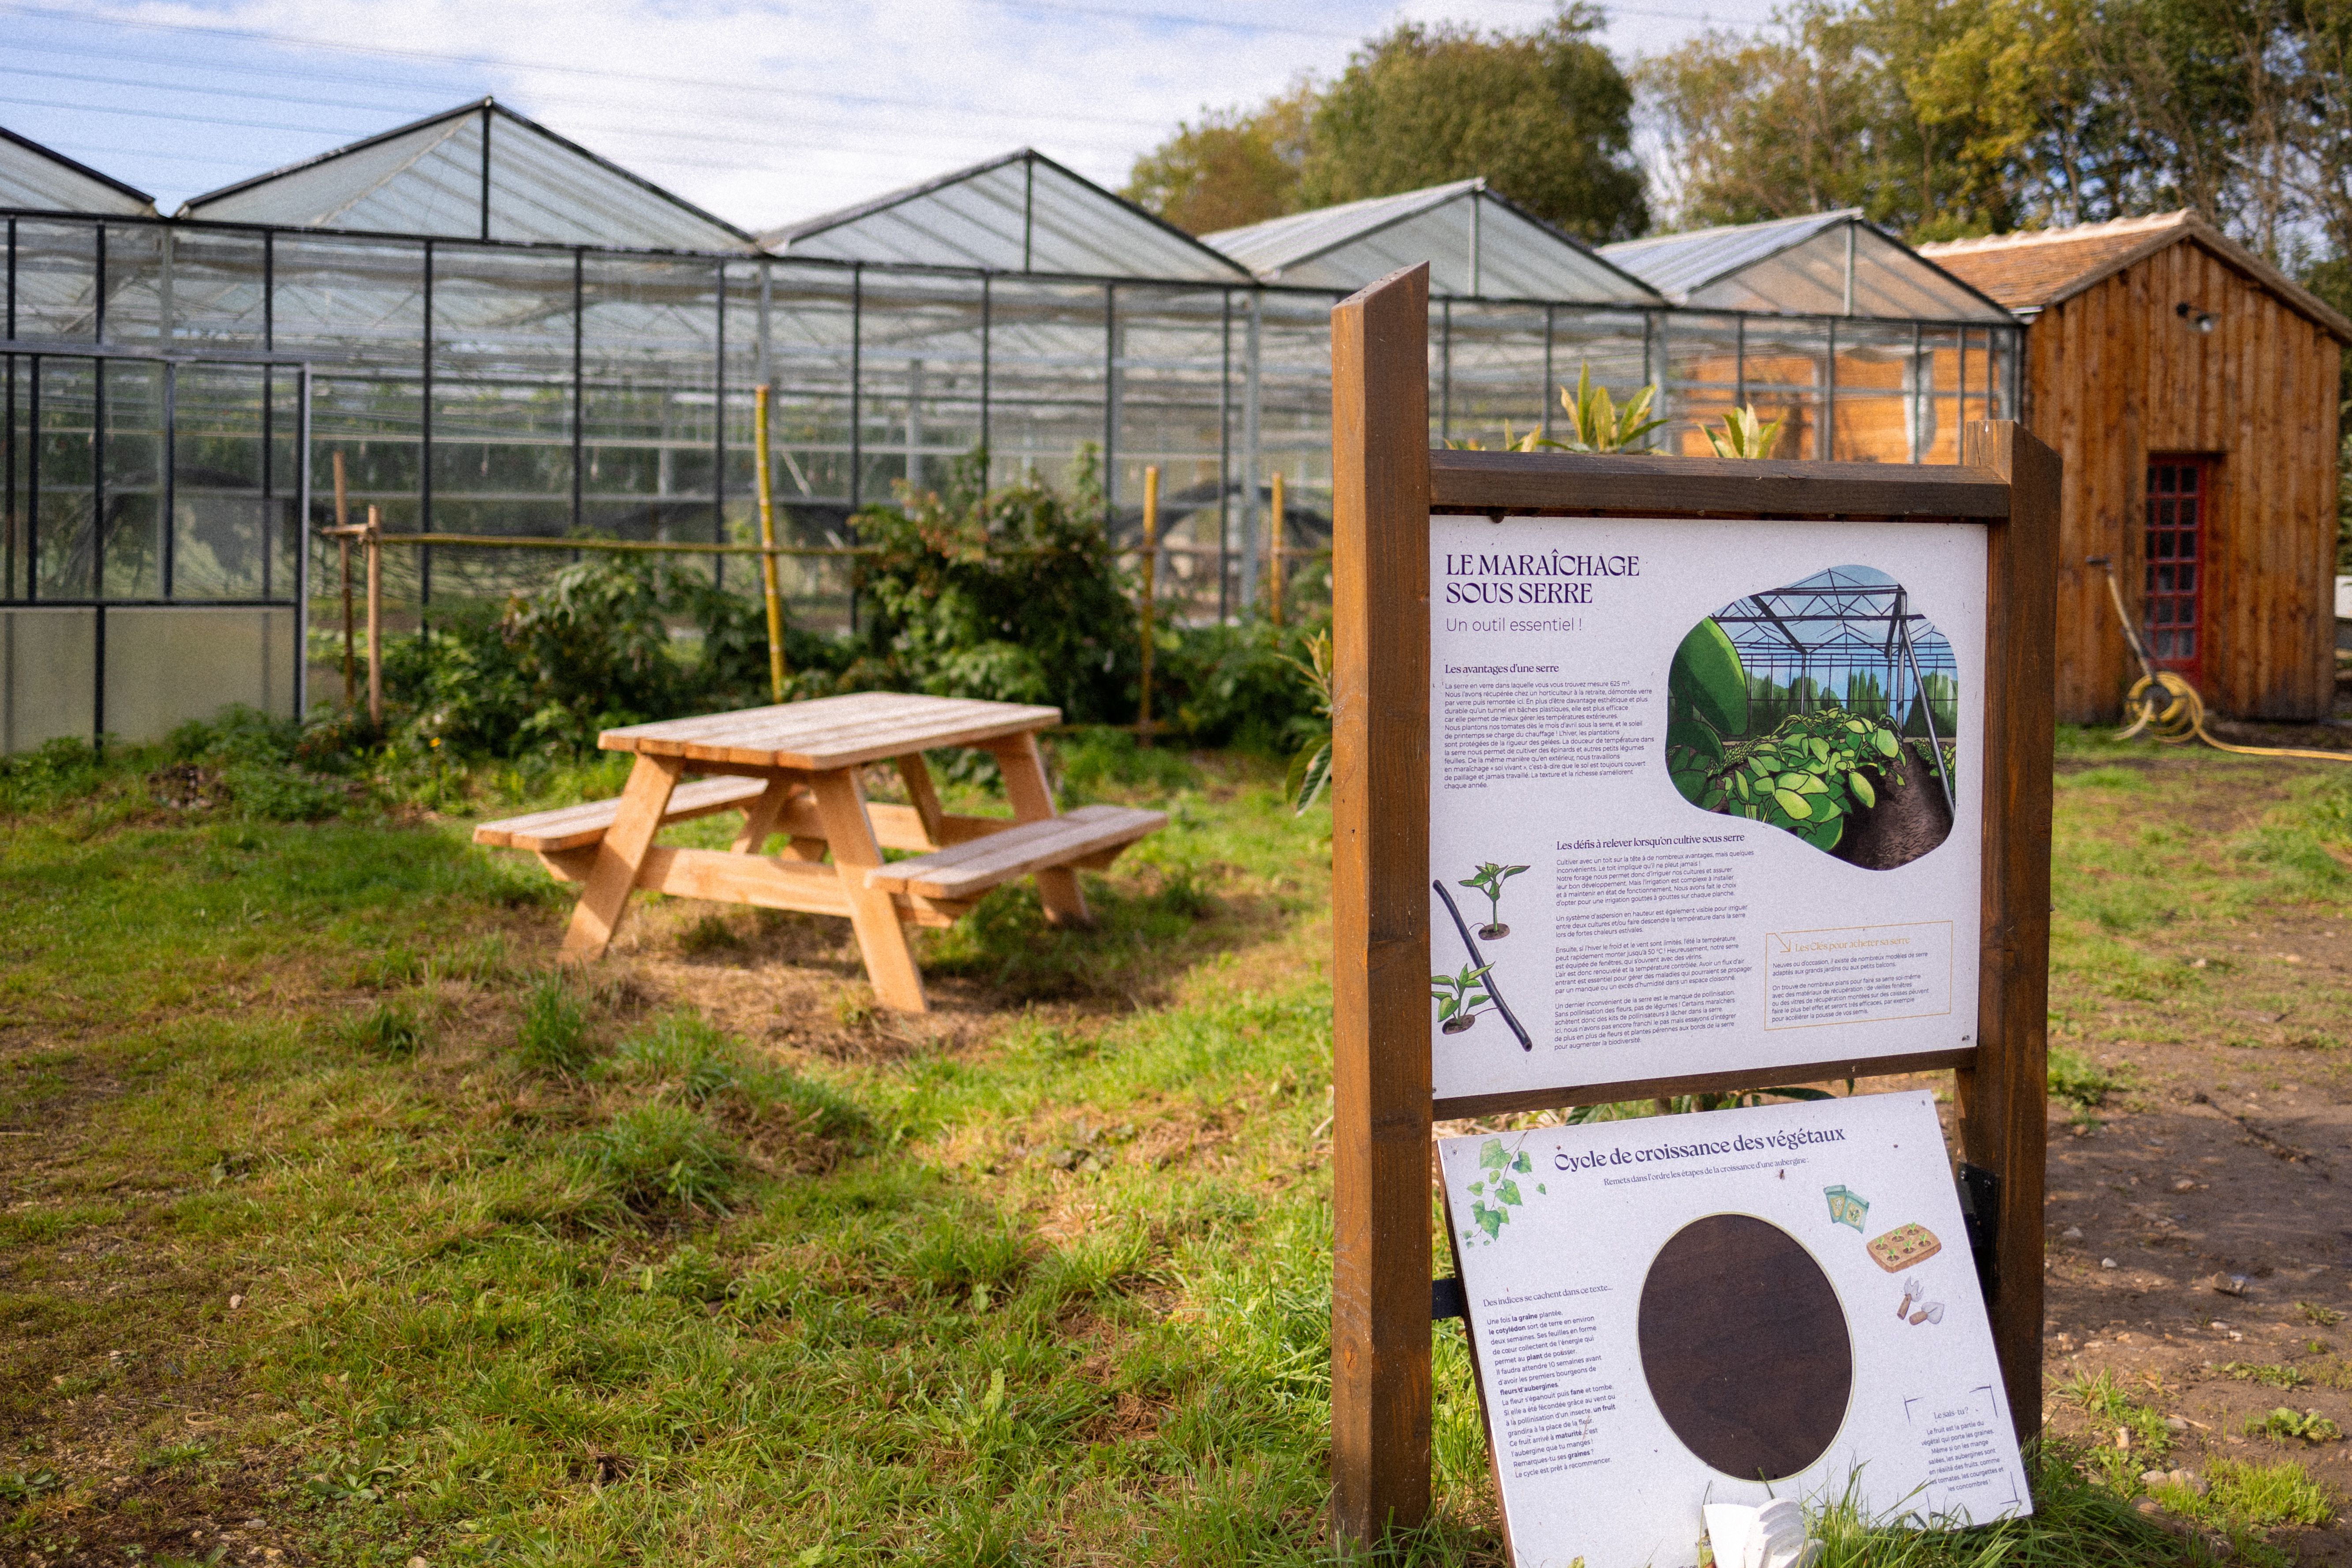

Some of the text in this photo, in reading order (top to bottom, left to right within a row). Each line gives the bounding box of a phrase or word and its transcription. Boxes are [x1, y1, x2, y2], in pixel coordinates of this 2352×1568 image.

[1446, 548, 1639, 576] LE MARAÎCHAGE
[1446, 582, 1593, 604] SOUS SERRE
[1447, 618, 1467, 631] Un
[1472, 617, 1504, 631] outil
[1510, 617, 1574, 631] essentiel
[1445, 664, 1461, 673] Les
[1462, 665, 1508, 675] avantages
[1510, 663, 1534, 673] d'une
[1557, 841, 1572, 849] Les
[1573, 839, 1594, 849] défis
[1596, 839, 1601, 848] à
[1603, 838, 1632, 848] relever
[1634, 836, 1672, 848] lorsqu'on
[1673, 835, 1701, 844] cultive
[1555, 1127, 1845, 1172] Cycle de croissance des végétaux
[1604, 1177, 1630, 1186] Remets
[1647, 1172, 1670, 1180] l'ordre
[1681, 1169, 1704, 1178] étapes
[1720, 1164, 1755, 1172] croissance
[1498, 1296, 1523, 1305] indices
[1533, 1291, 1562, 1300] cachent
[1518, 1313, 1537, 1322] graine
[1495, 1325, 1526, 1334] cotylédon
[1494, 1357, 1516, 1366] permet
[1526, 1353, 1543, 1362] plant
[1517, 1382, 1559, 1392] d'aubergines.
[1511, 1447, 1544, 1457] l'aubergine
[1523, 1469, 1538, 1477] cycle
[1550, 1464, 1563, 1473] prêt
[1569, 1457, 1612, 1469] recommencer.
